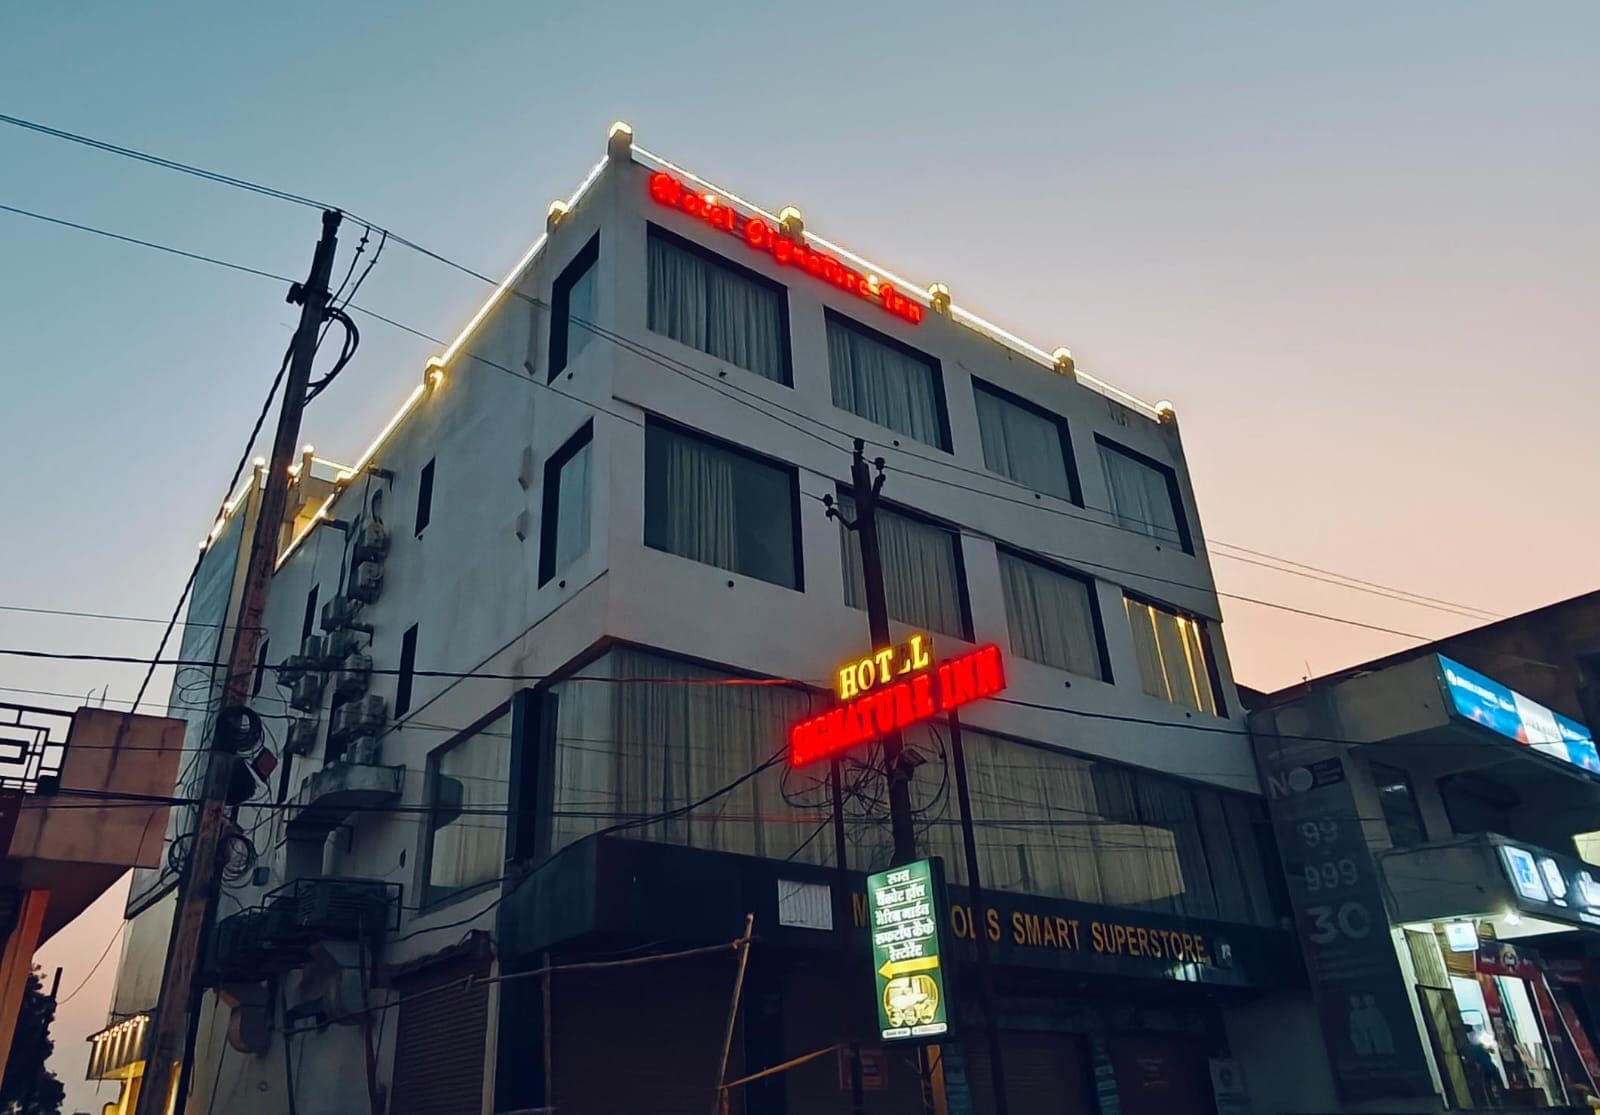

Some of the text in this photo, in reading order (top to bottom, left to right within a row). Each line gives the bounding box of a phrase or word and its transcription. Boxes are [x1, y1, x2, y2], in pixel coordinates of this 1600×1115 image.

[938, 645, 1004, 709] INN
[1012, 911, 1079, 950] SMART
[1091, 921, 1206, 963] SUPERSTORE
